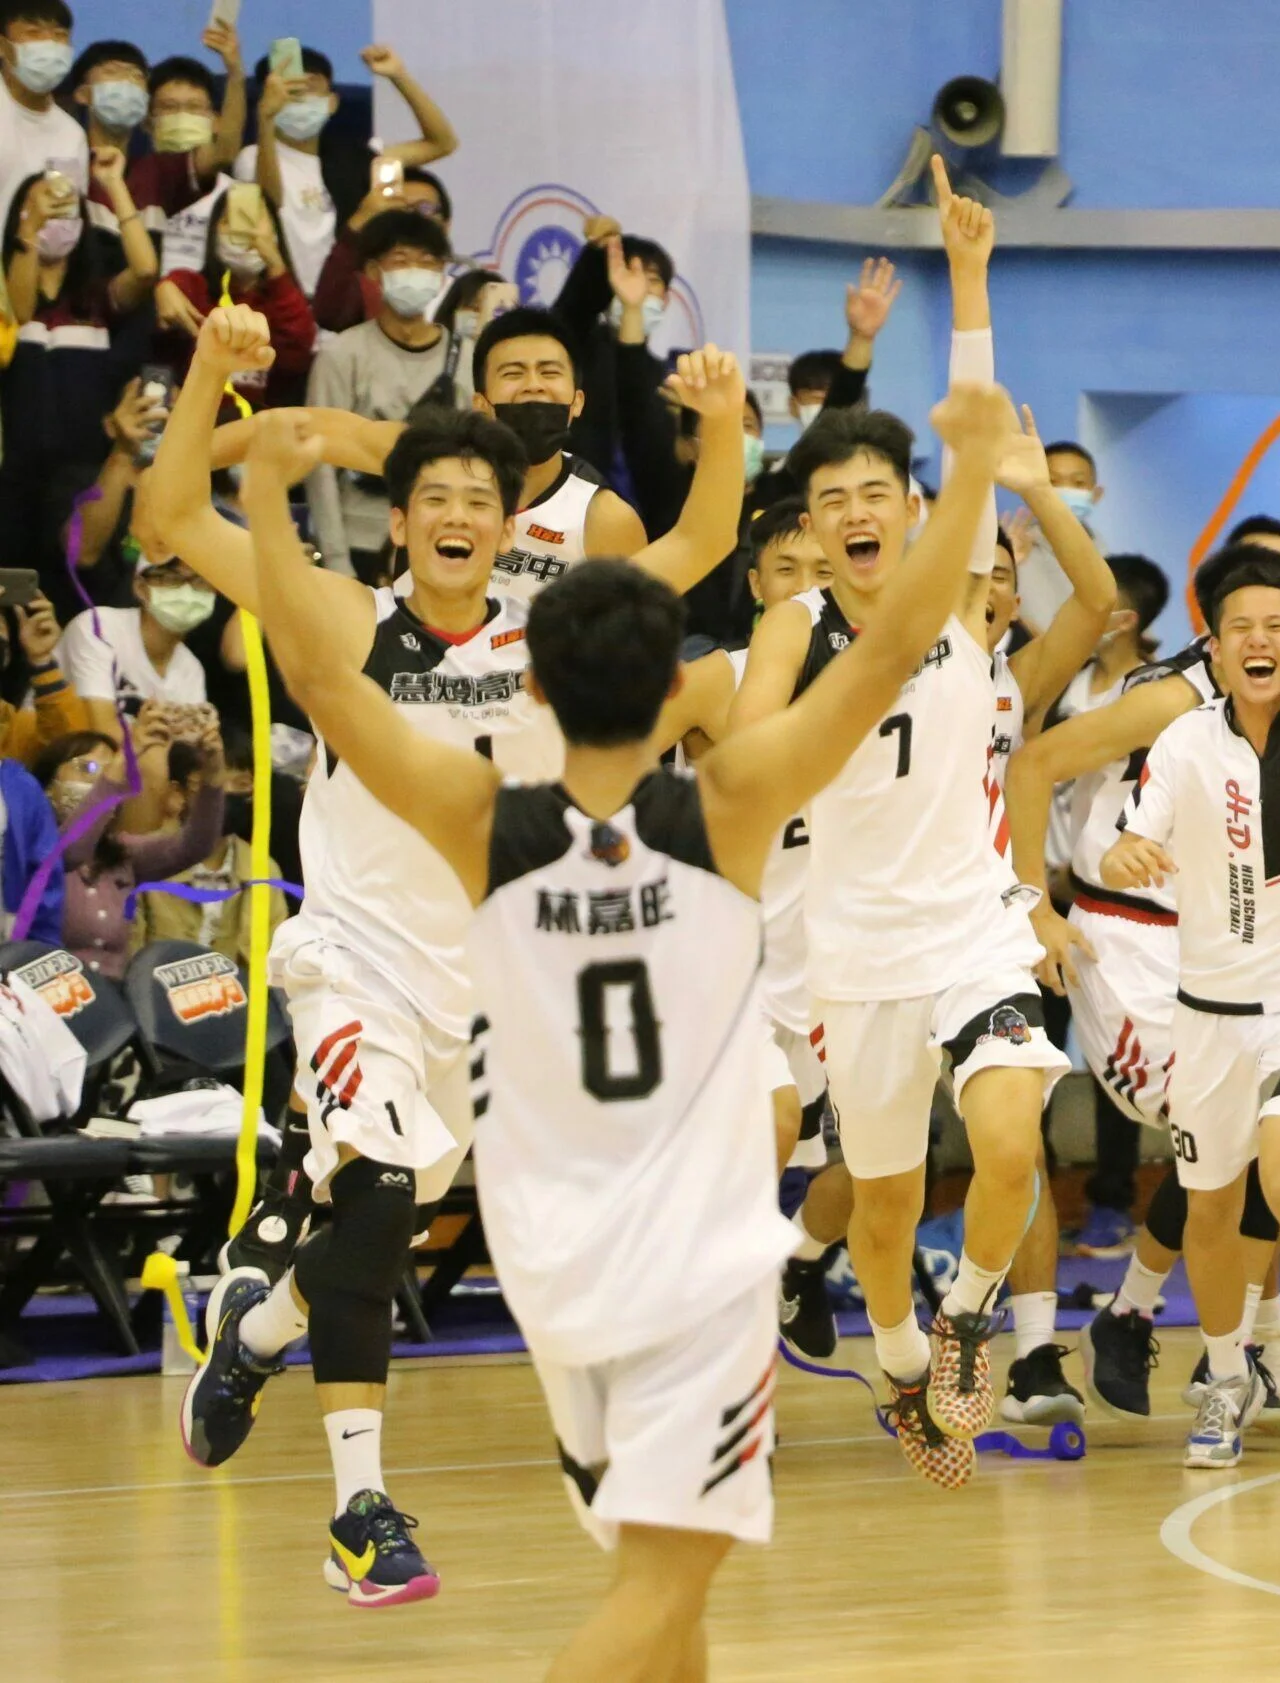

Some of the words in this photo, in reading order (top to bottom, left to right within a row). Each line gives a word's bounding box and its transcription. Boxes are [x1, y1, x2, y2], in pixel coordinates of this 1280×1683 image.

[879, 713, 913, 779] 7
[1228, 862, 1241, 935] BASKETBALL
[1242, 864, 1254, 898] HIGH
[1242, 898, 1256, 944] SCHOOL
[18, 952, 75, 986] EIDER
[575, 956, 664, 1103] 0
